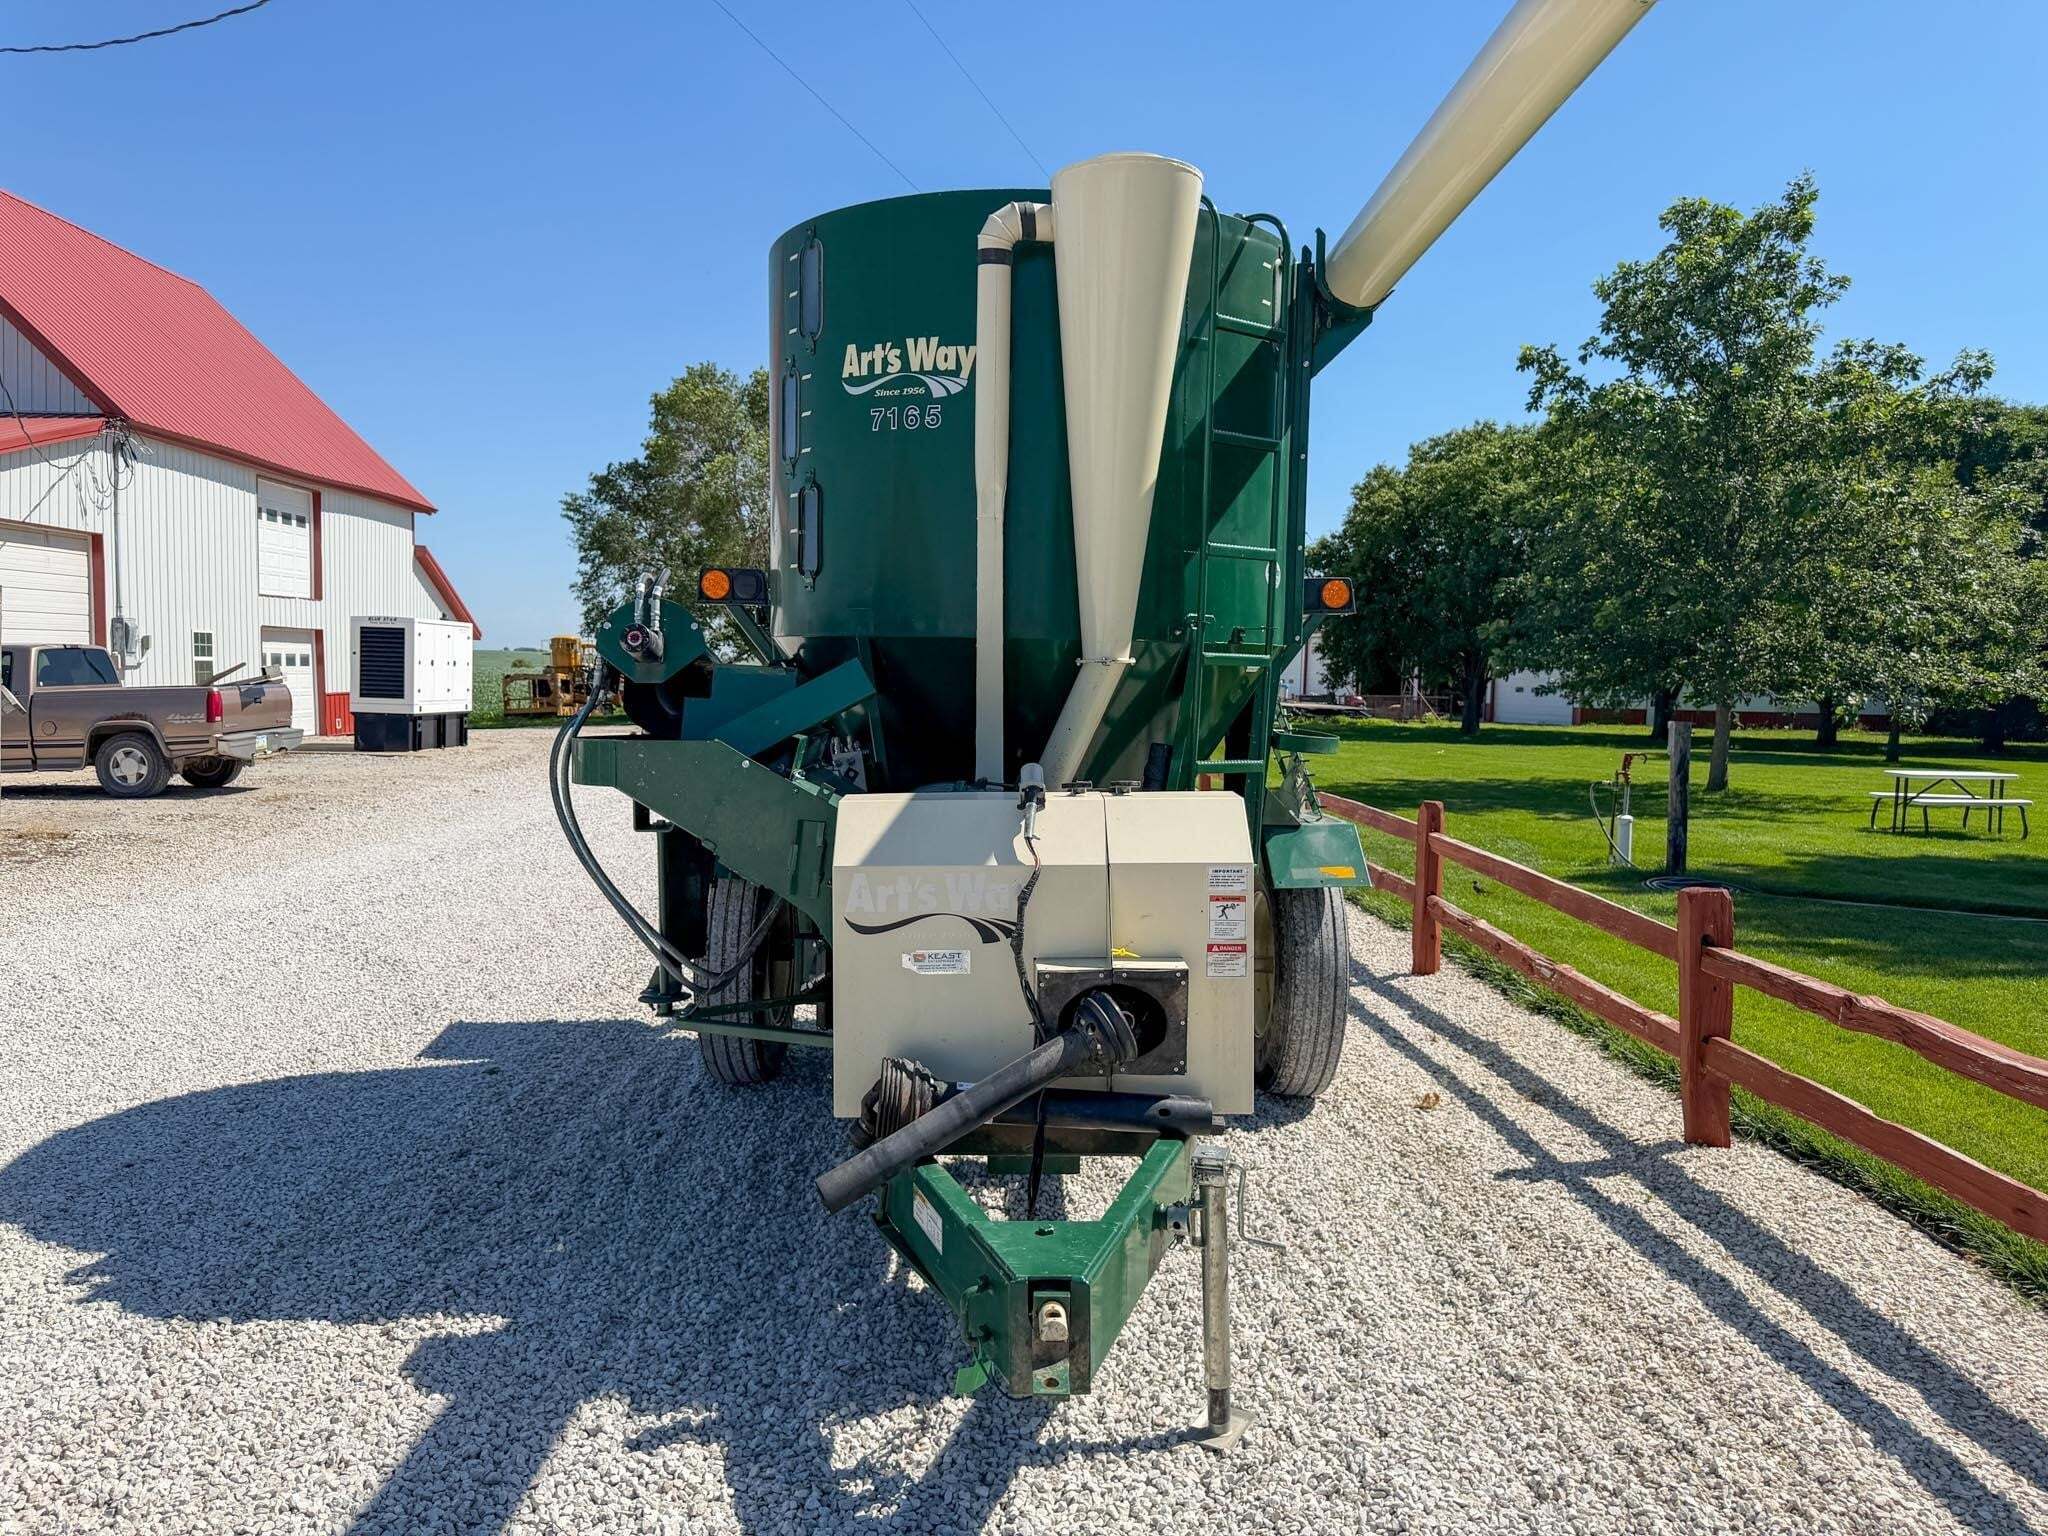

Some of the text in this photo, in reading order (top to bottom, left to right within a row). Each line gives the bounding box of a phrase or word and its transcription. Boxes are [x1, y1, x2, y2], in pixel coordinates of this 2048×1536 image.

[842, 336, 977, 380] Art's Way
[874, 387, 926, 397] Since 1956
[871, 404, 942, 431] 7165
[845, 872, 1018, 912] Art's Wa
